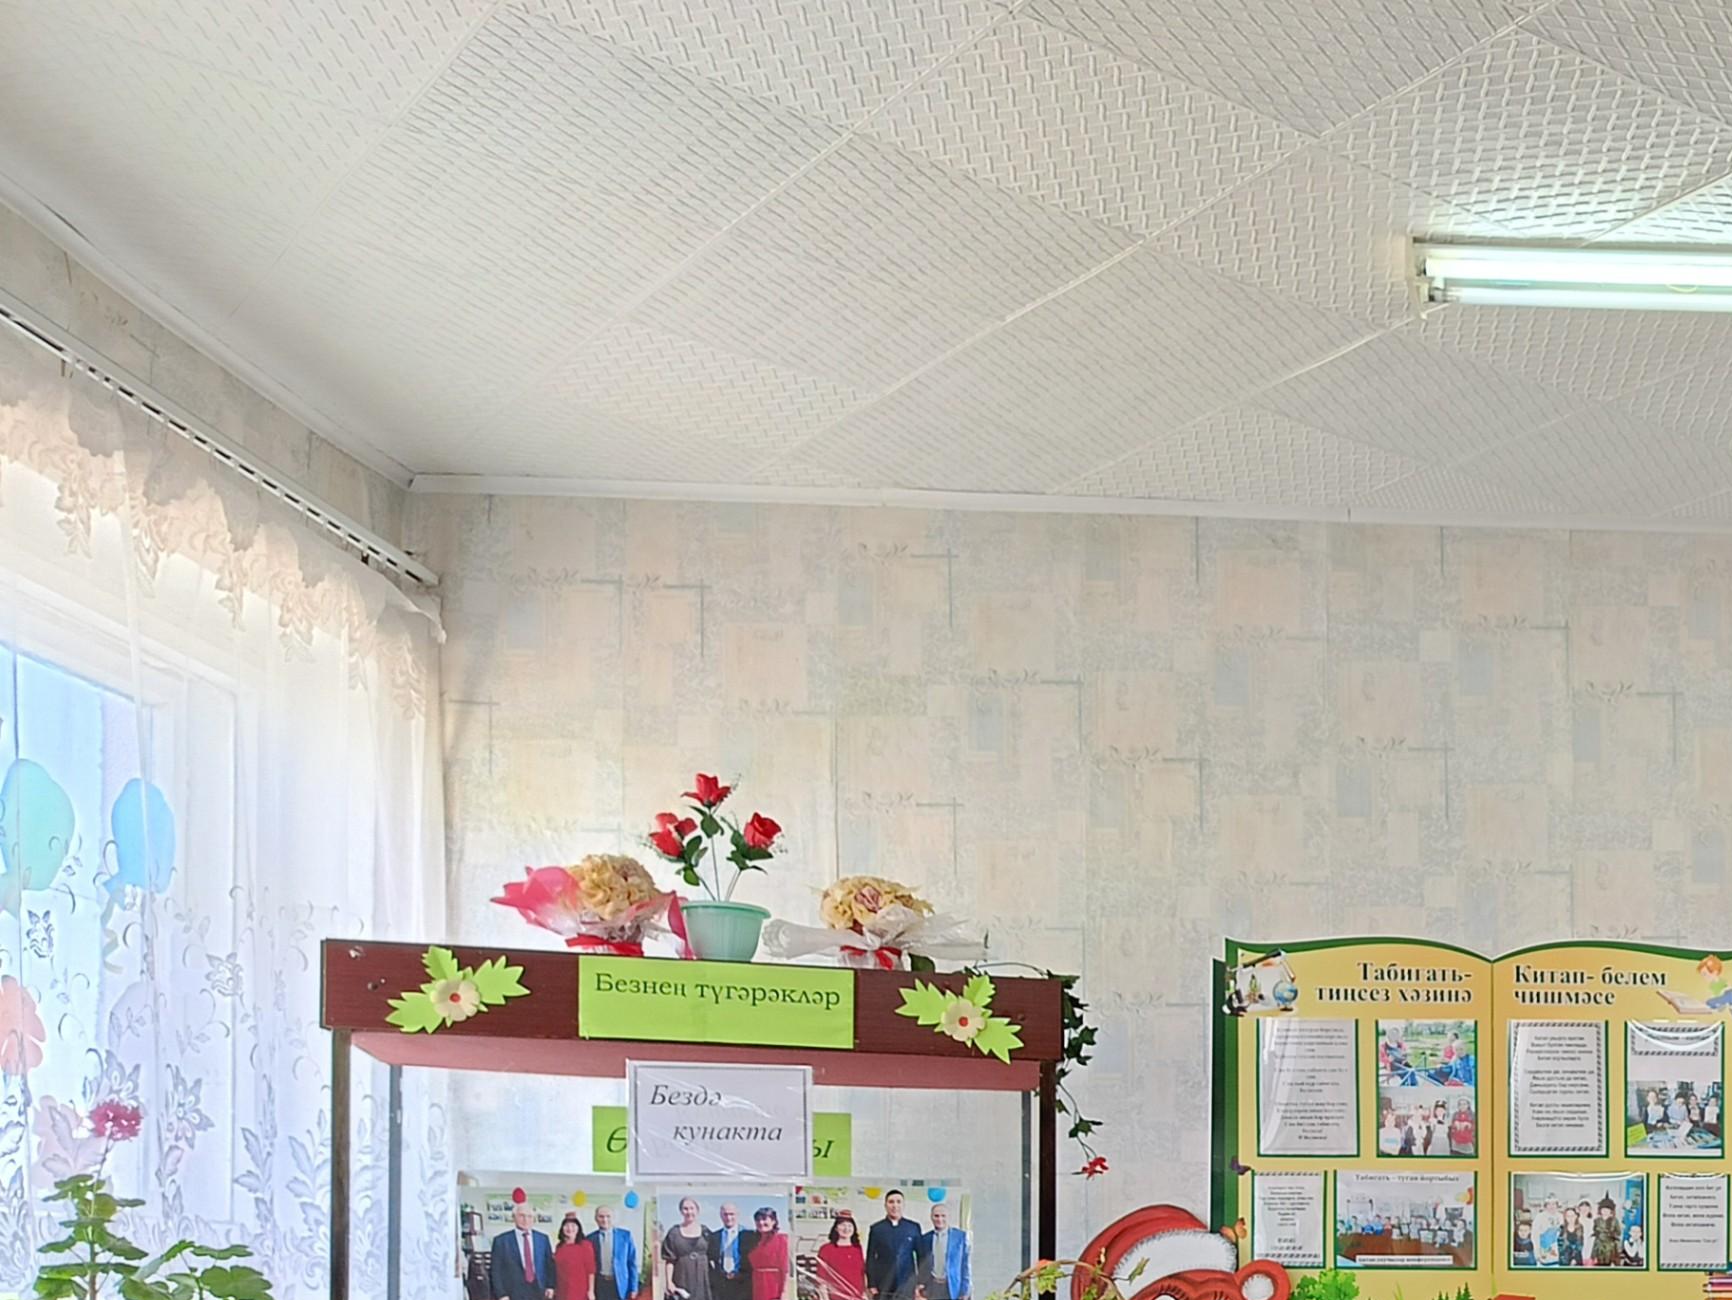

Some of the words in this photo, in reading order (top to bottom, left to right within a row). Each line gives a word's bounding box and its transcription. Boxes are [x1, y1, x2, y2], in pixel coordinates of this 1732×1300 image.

[1358, 962, 1473, 982] Табигать-
[1514, 964, 1595, 985] Китап-
[1601, 967, 1667, 986] белем
[595, 972, 687, 997] Безнең
[694, 983, 842, 1010] түгәрәкләр
[1315, 986, 1390, 1003] тиңсез
[1398, 988, 1473, 1003] хәзинә
[1514, 989, 1616, 1005] чишмәсе
[650, 1084, 722, 1106] Бездә
[673, 1125, 783, 1146] кунакта
